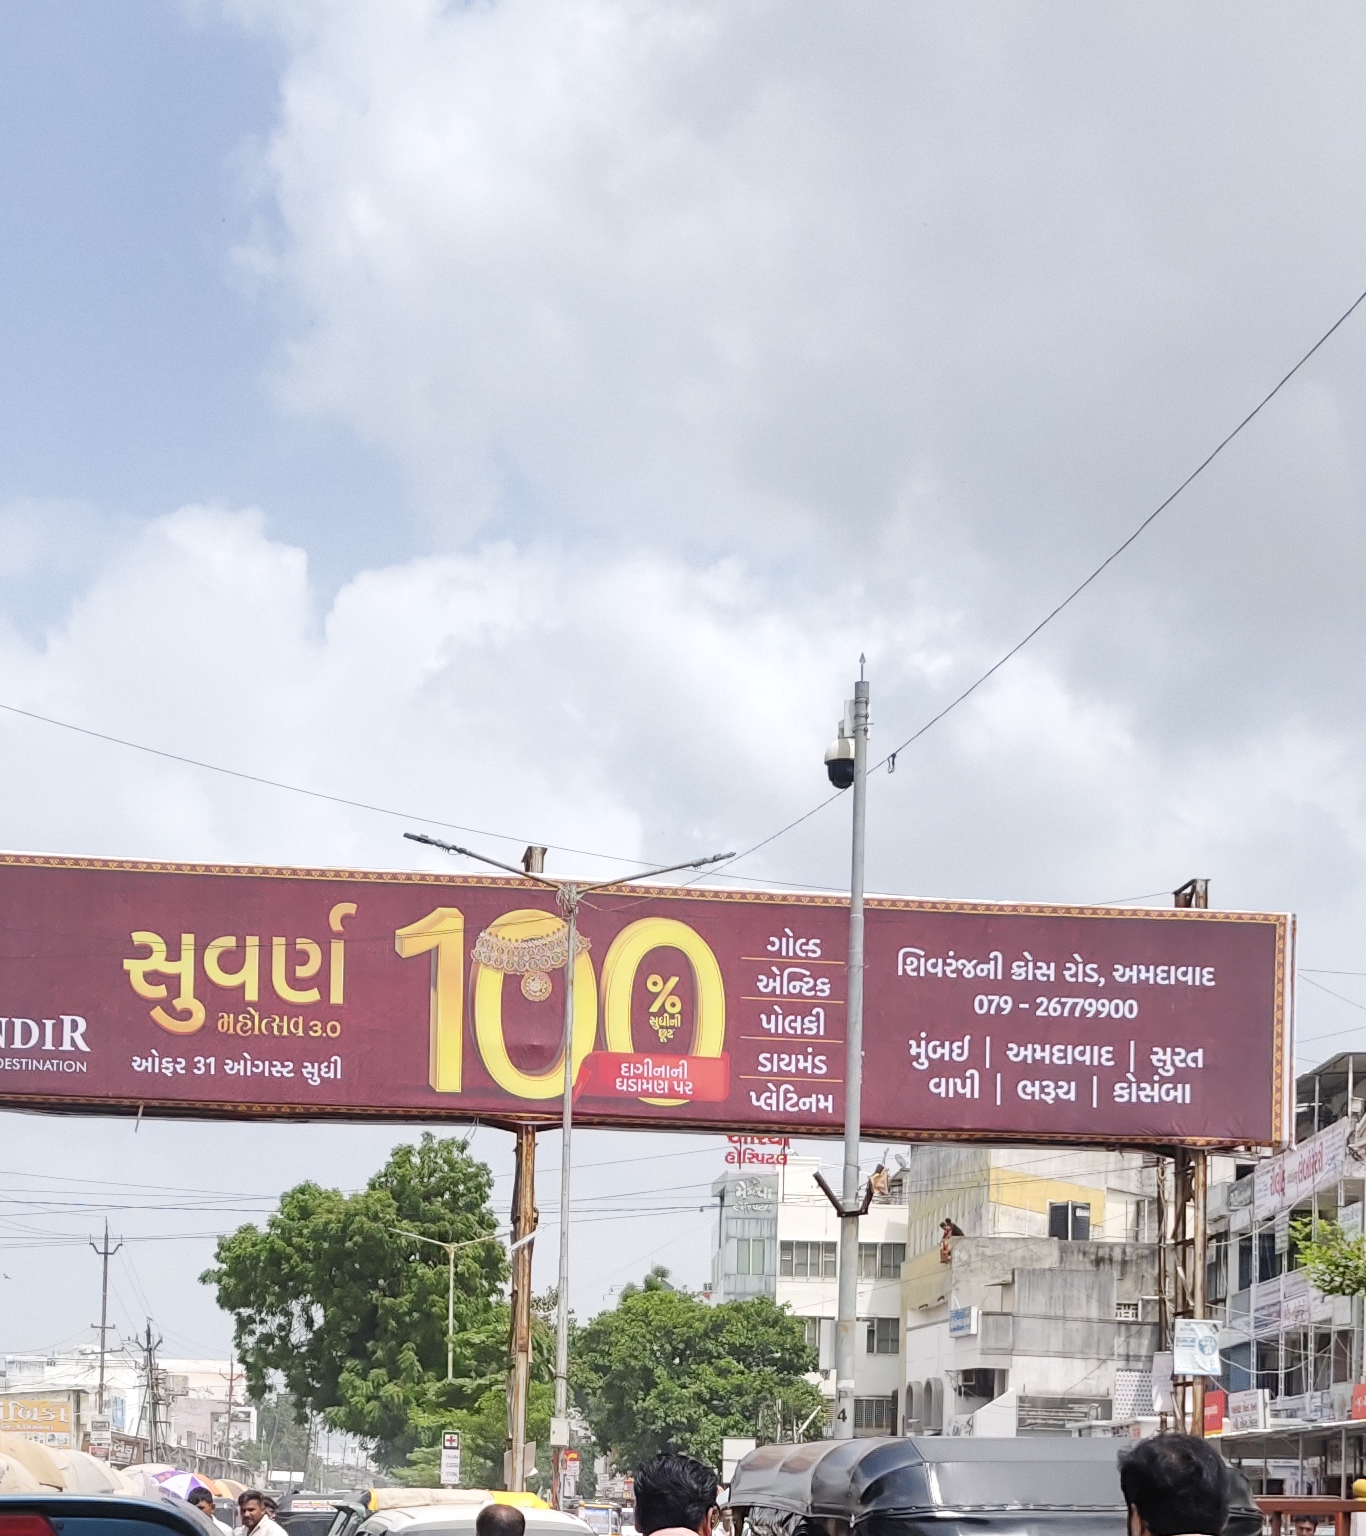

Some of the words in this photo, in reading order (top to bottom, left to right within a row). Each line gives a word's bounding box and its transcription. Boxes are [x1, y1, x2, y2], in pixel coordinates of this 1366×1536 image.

[766, 927, 822, 958] ગોલ્ડ
[123, 902, 358, 1036] સુવર્ણ
[757, 966, 831, 997] એન્ટિક
[897, 947, 1003, 981] શિવરંજની
[1010, 952, 1055, 982] ક્રોસ
[1063, 954, 1106, 987] રોડ,
[1112, 962, 1216, 987] અમદાવાદ
[217, 1007, 306, 1037] મહોત્સવ
[649, 1013, 682, 1031] સુધીની
[760, 1005, 825, 1036] પોલકી
[973, 995, 1013, 1015] 079
[1035, 997, 1138, 1019] 26779900
[131, 1049, 186, 1077] ઓફર
[193, 1056, 215, 1075] 31
[223, 1052, 295, 1078] ઓગસ્ટ
[301, 1055, 343, 1086] સુધી
[620, 1057, 688, 1079] દાગીનાની
[757, 1047, 828, 1075] ડાયમંડ
[909, 1032, 971, 1070] મુંબઈ
[1006, 1043, 1115, 1067] અમદાવાદ
[1150, 1046, 1204, 1077] સુરત
[615, 1078, 669, 1094] ઘડામણ
[673, 1081, 694, 1095] પર
[749, 1083, 833, 1114] પ્લેટિનમ
[928, 1069, 980, 1099] વાપી
[1017, 1079, 1076, 1105] ભરૂચ
[1113, 1072, 1191, 1105] કોસંબા
